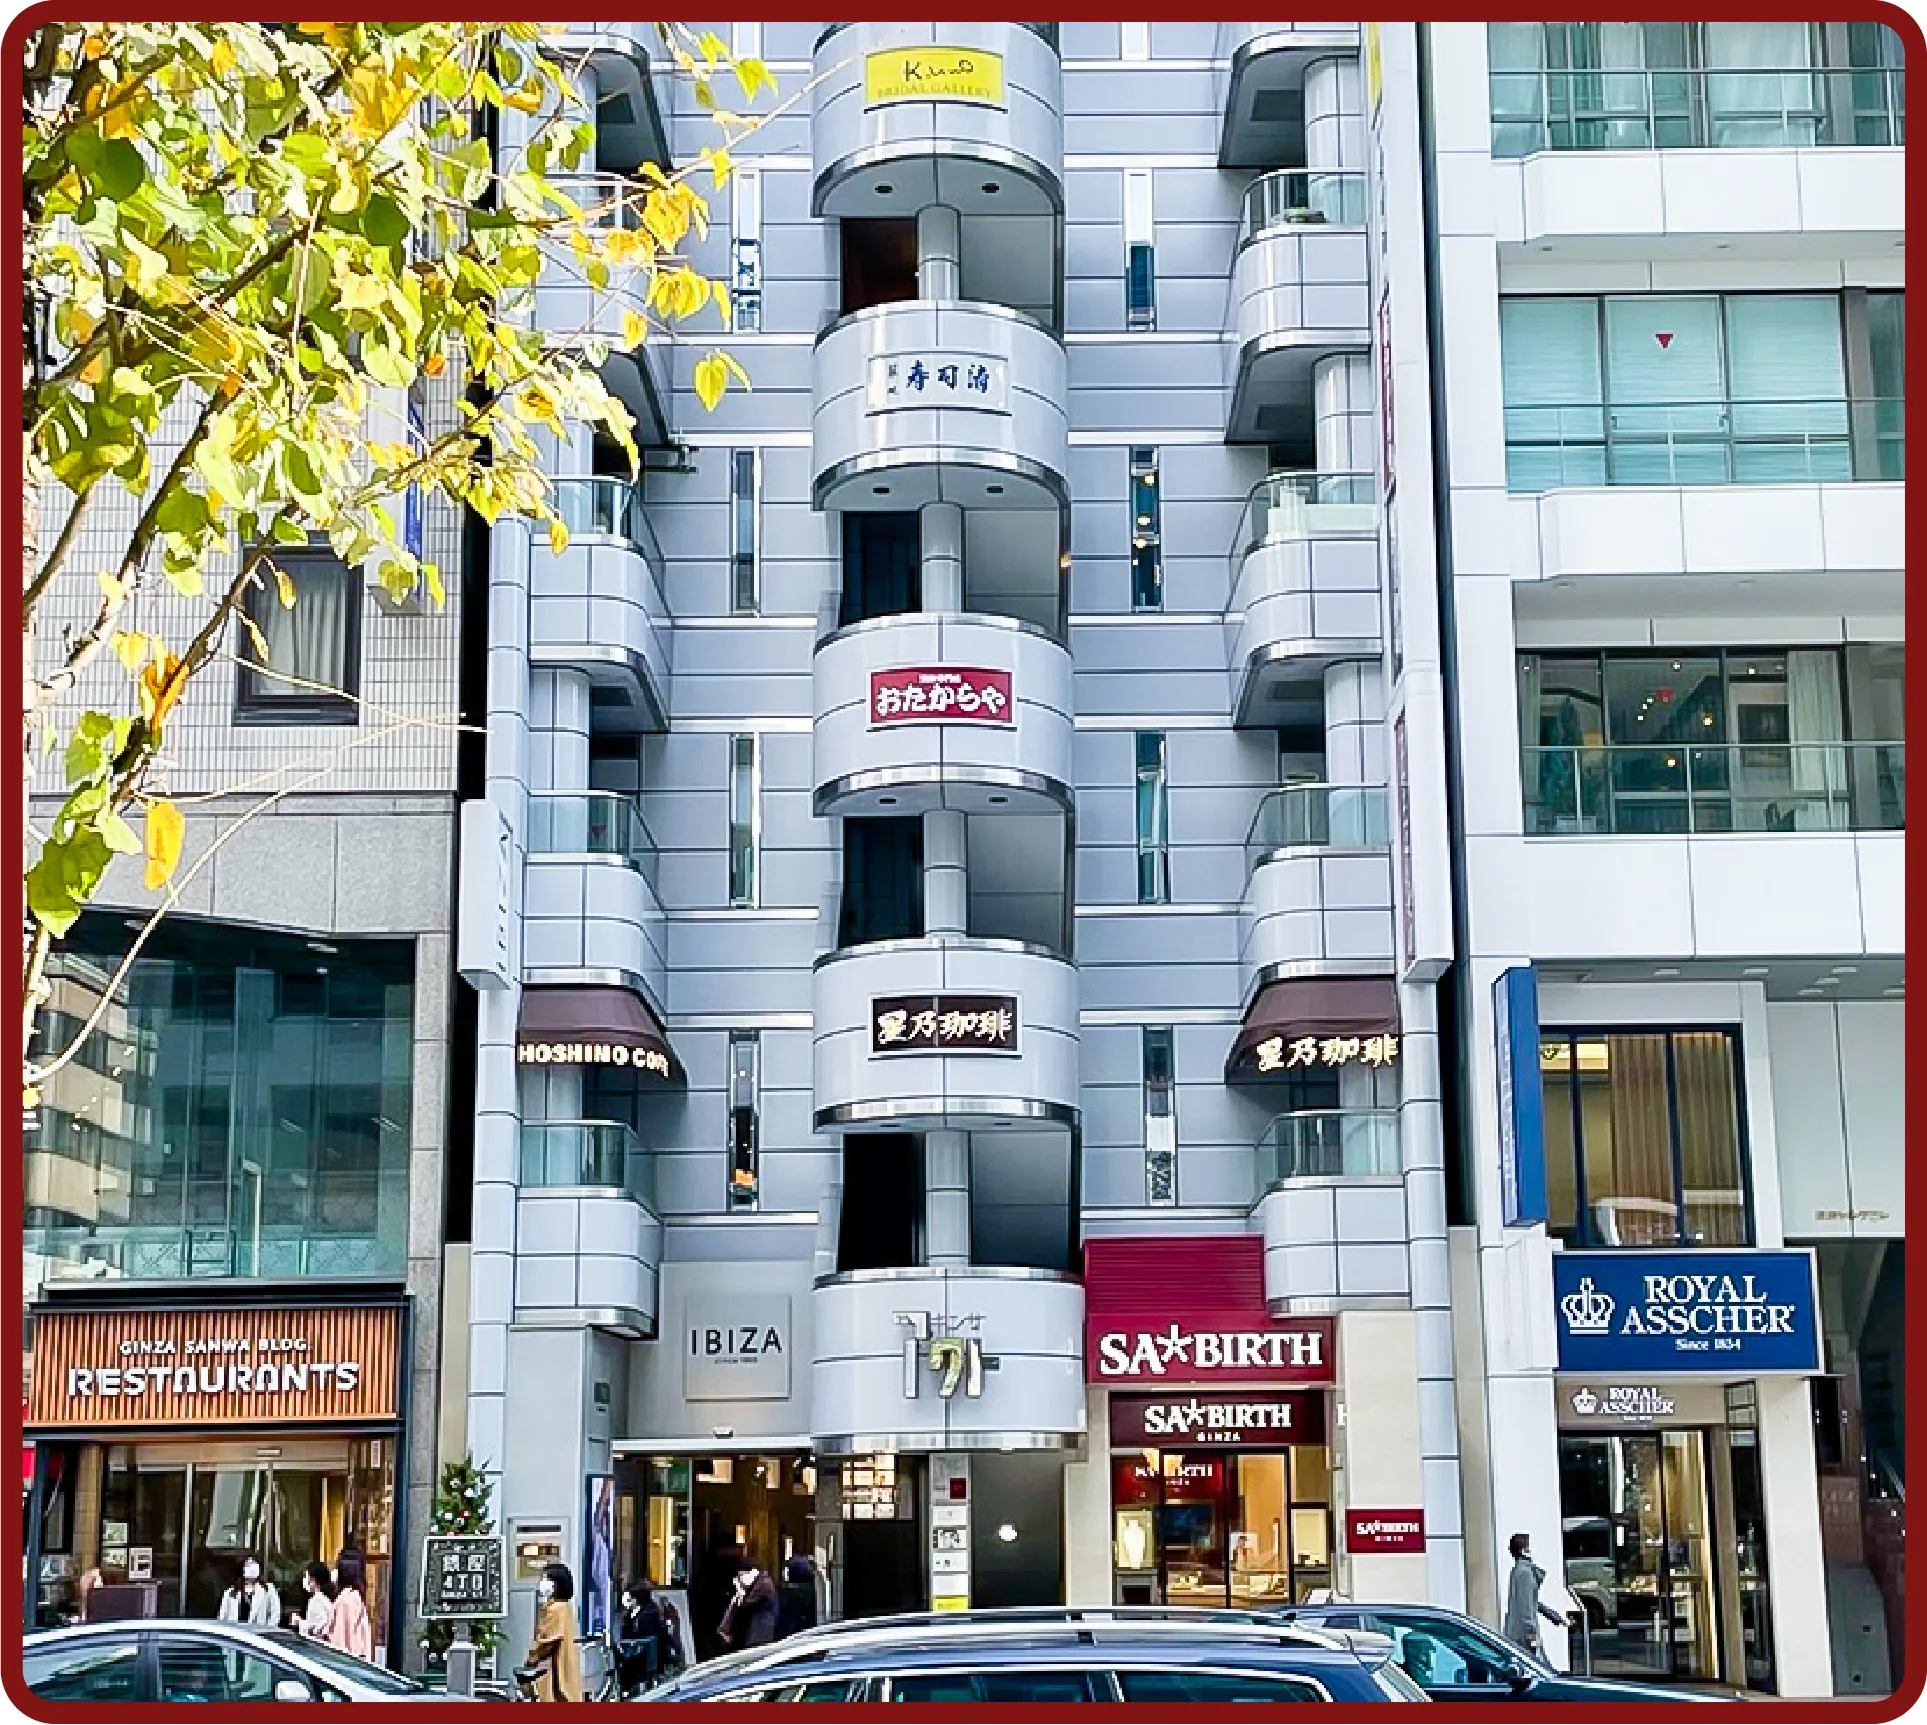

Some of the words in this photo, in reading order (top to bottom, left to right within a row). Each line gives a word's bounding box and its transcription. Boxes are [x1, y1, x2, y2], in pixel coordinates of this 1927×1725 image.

[877, 682, 1006, 717] おたからや
[518, 1043, 630, 1066] HOSHINO
[1643, 1275, 1769, 1304] ROYAL
[1618, 1304, 1796, 1335] ASSCHER
[119, 1341, 176, 1357] GINZA
[184, 1338, 251, 1355] SANWA
[691, 1326, 783, 1356] IBIZA
[67, 1361, 361, 1396] RESTAURANTS
[1598, 1398, 1676, 1414] ASSCHER
[1609, 1387, 1663, 1400] ROYAL
